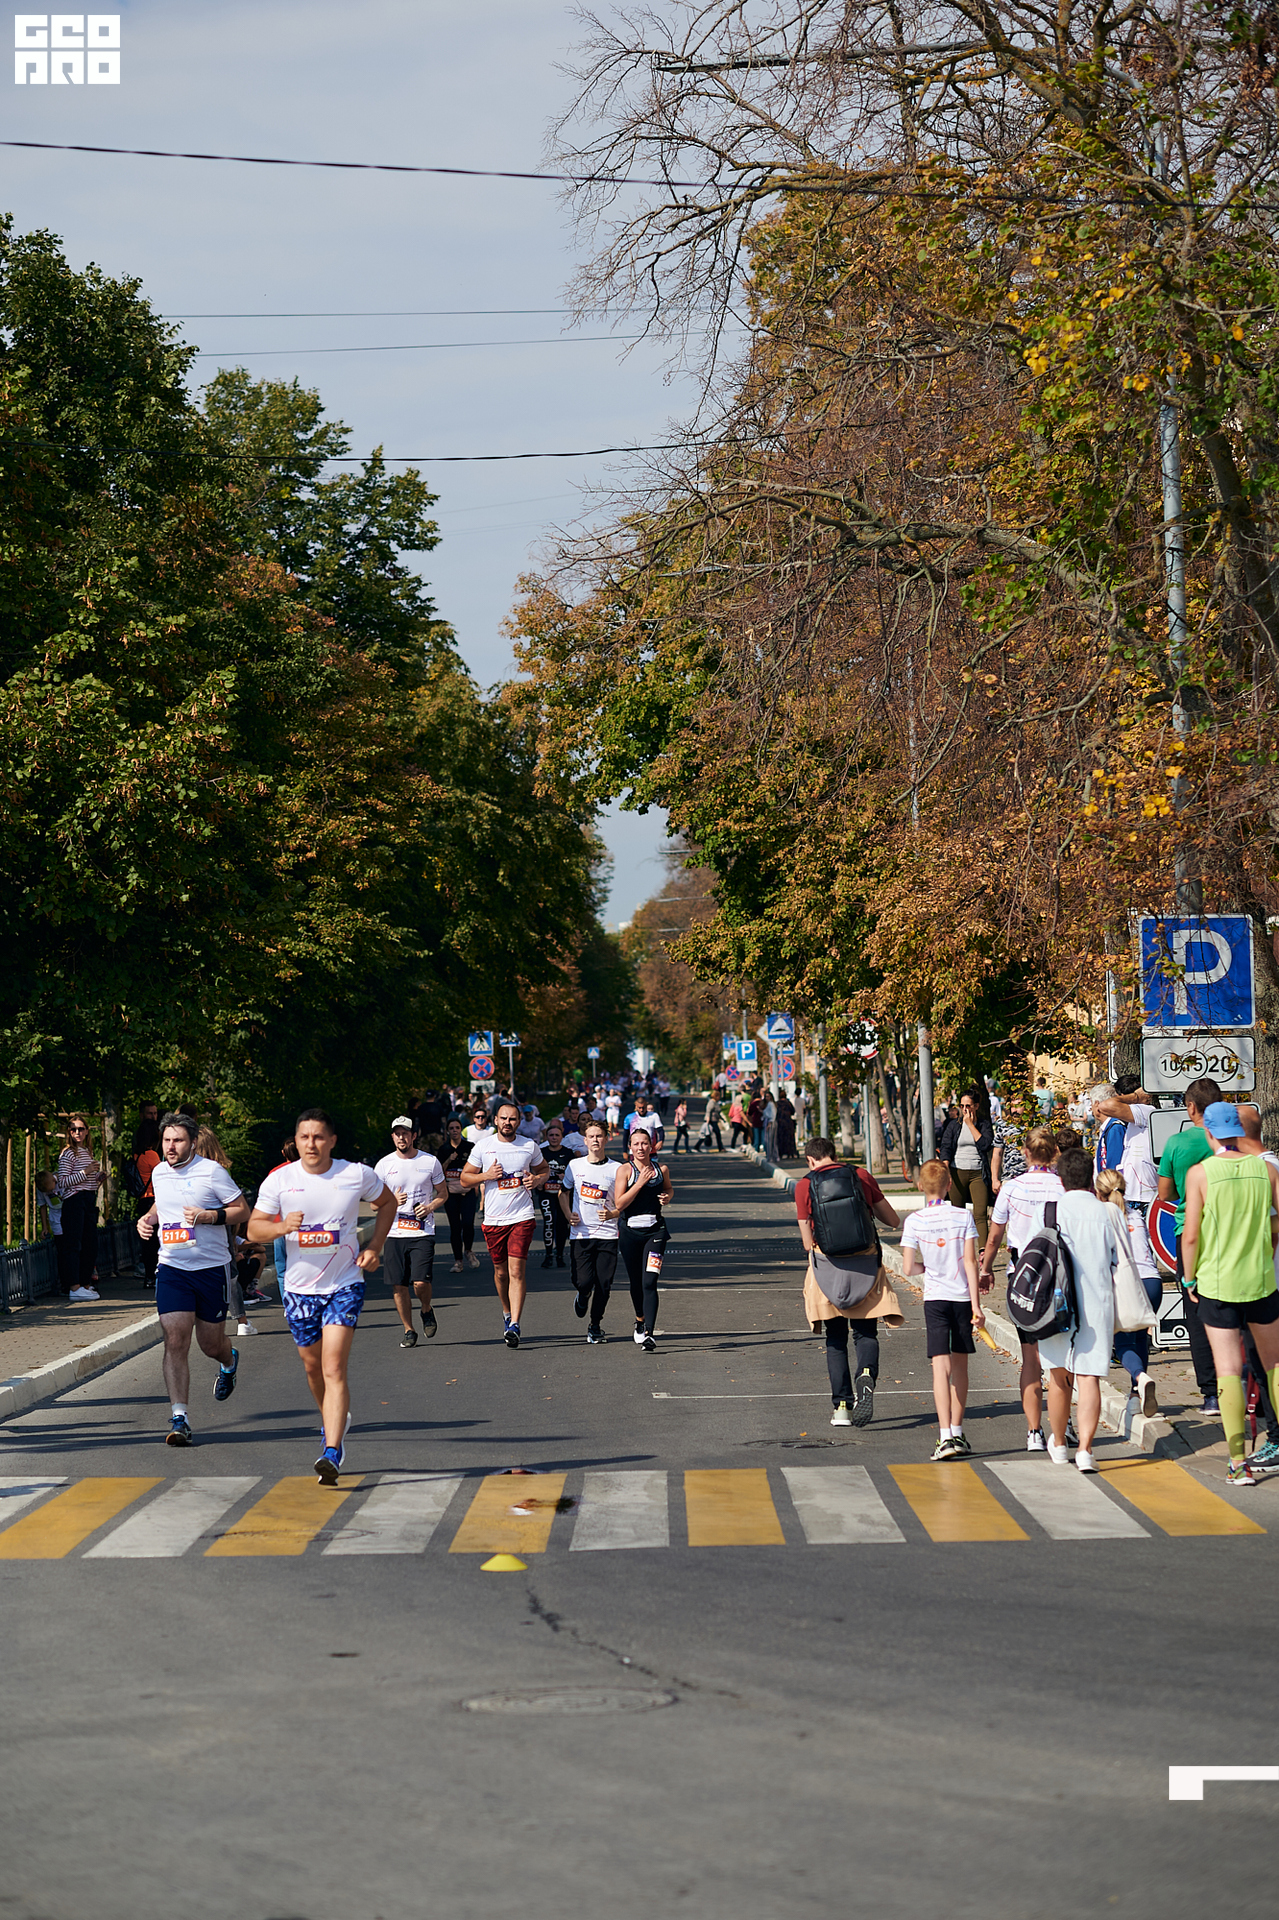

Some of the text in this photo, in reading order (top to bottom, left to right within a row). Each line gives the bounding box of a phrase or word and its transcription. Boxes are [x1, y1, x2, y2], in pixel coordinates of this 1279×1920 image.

[1173, 929, 1232, 1014] P
[741, 1043, 753, 1059] P
[500, 1179, 519, 1188] 5253
[582, 1188, 602, 1198] 5516
[399, 1220, 420, 1229] 5259
[164, 1230, 187, 1241] 5114
[301, 1233, 331, 1244] 5500
